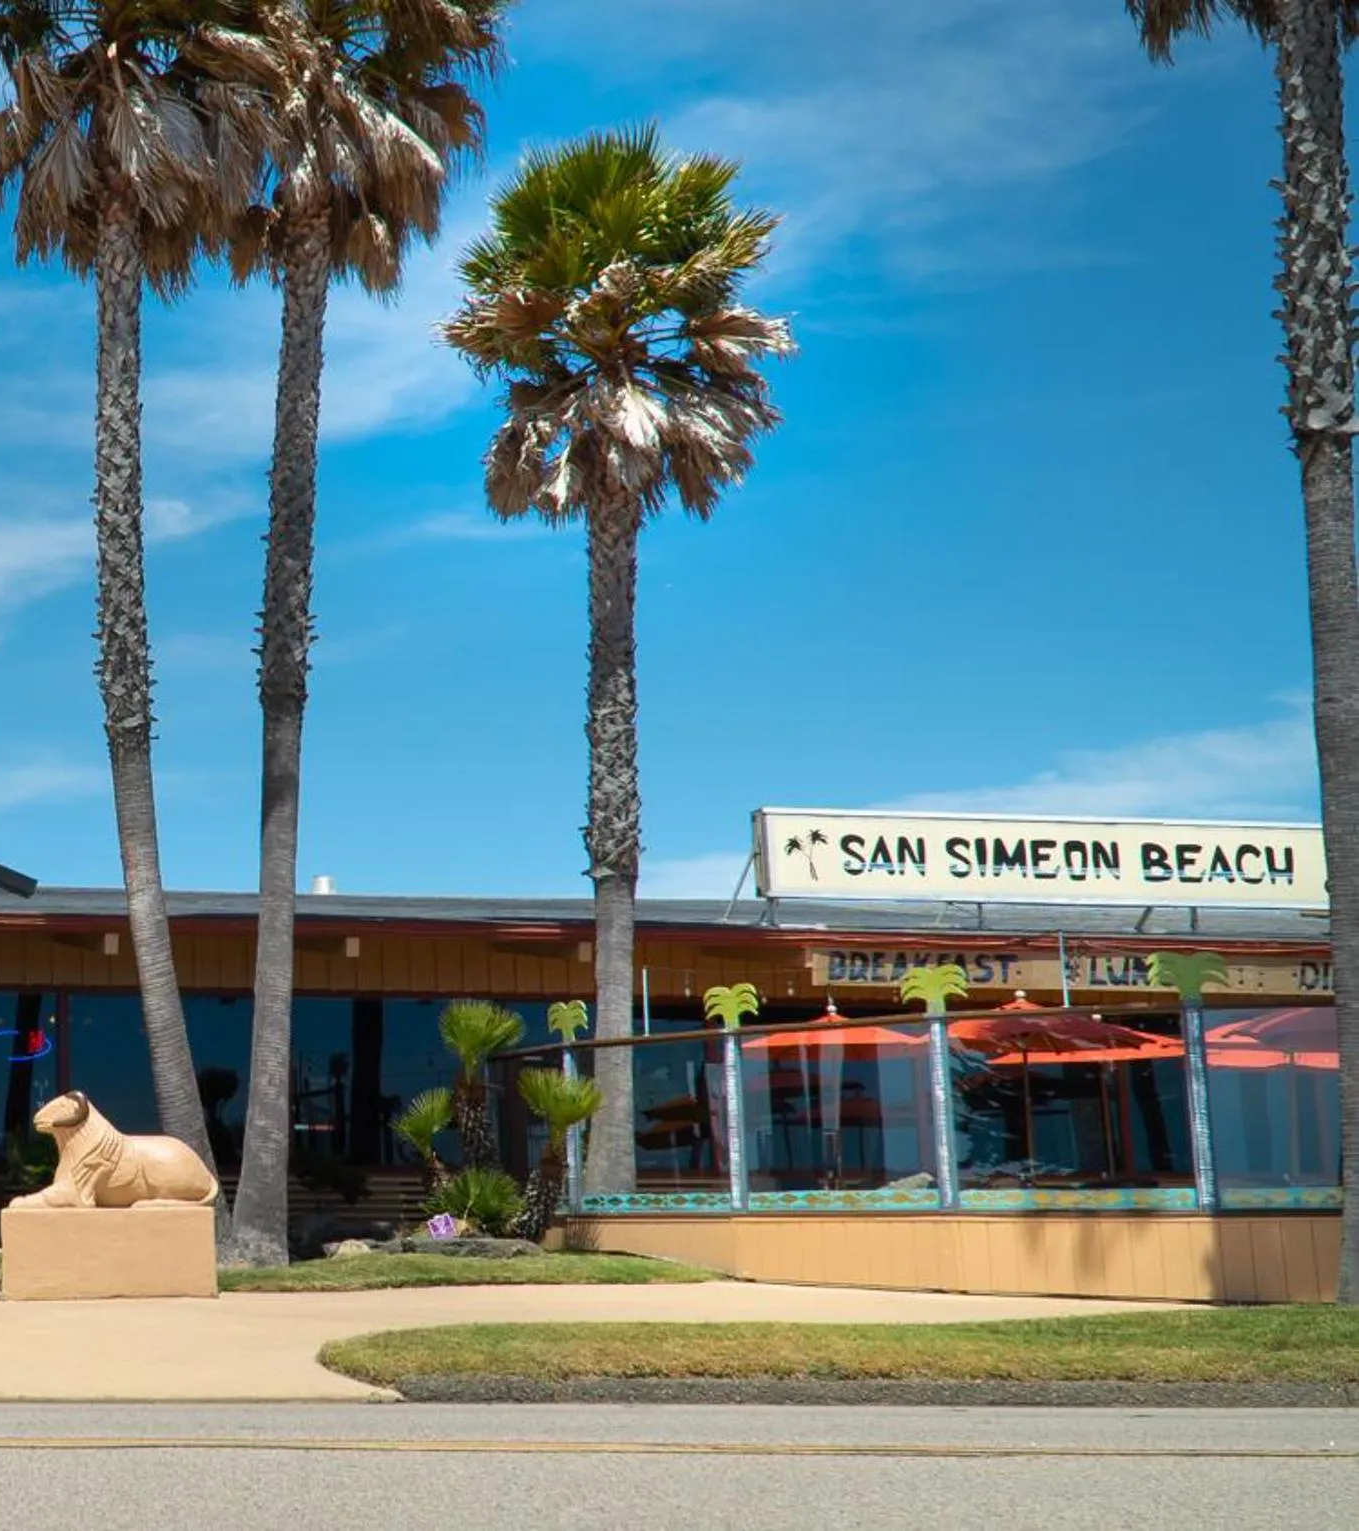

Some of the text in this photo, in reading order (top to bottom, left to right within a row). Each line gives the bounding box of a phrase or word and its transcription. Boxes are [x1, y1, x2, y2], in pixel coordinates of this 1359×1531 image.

[840, 834, 1294, 885] SAN SIMEON BEACH
